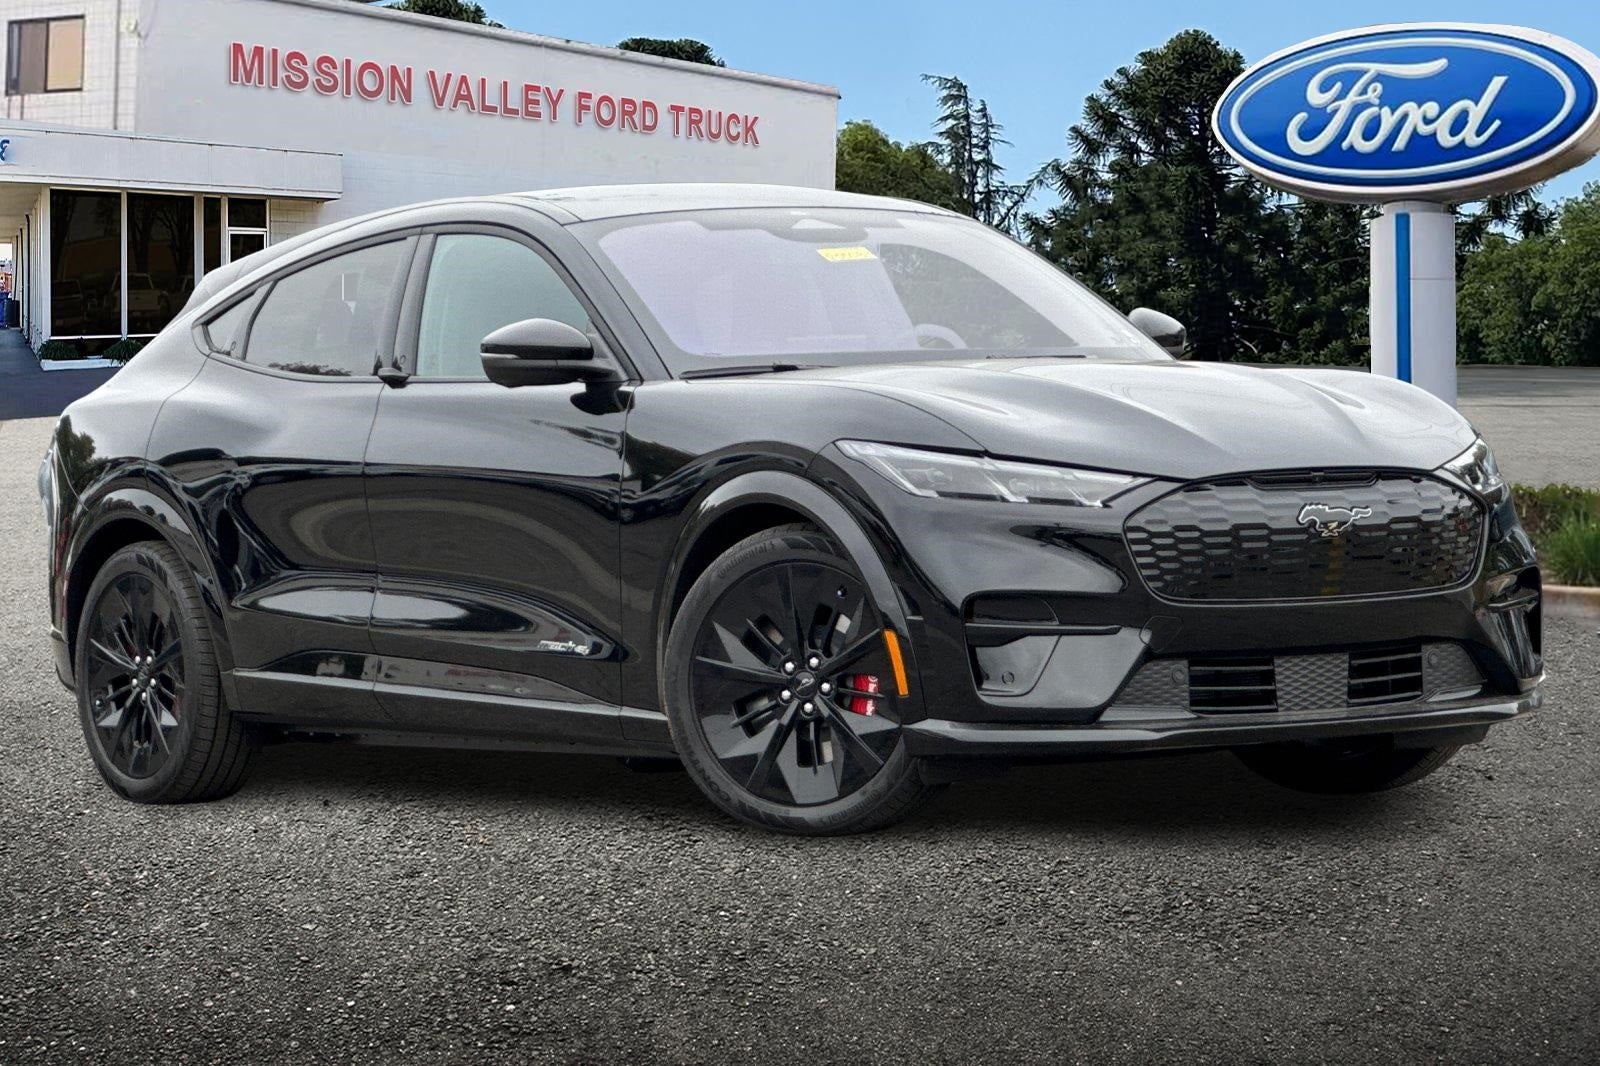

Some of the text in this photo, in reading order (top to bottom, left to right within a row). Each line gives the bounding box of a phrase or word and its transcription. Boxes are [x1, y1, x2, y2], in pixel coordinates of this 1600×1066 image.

[229, 41, 760, 146] MISSION VALLEY FORD TRUCK
[1286, 57, 1509, 157] Ford
